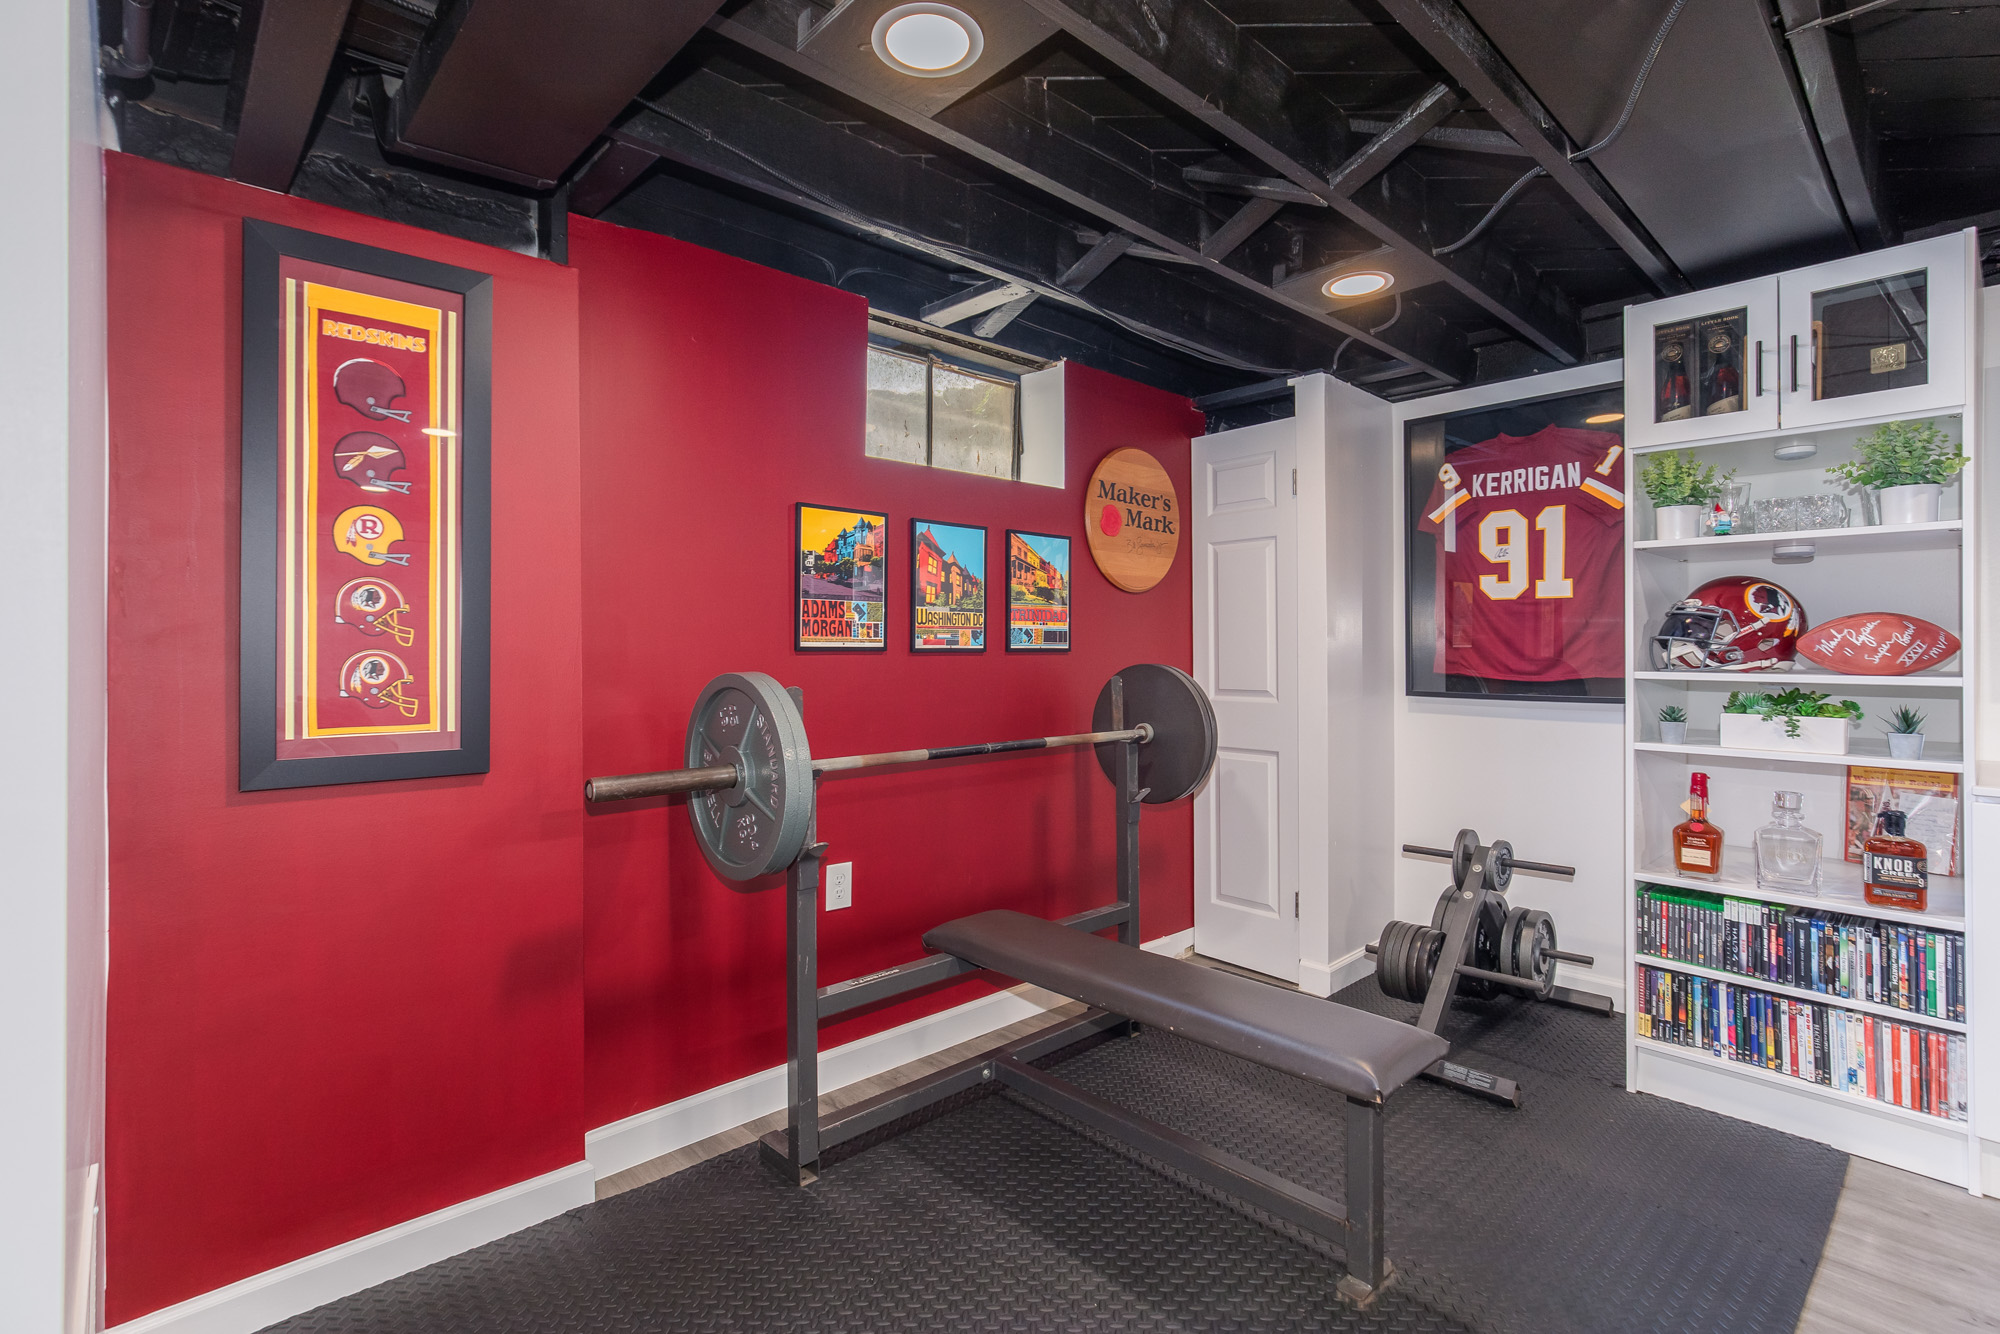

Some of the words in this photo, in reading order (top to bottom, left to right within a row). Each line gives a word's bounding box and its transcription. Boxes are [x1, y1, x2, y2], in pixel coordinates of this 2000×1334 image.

[321, 318, 427, 354] REDSKINS
[1438, 462, 1462, 490] 9
[1472, 461, 1581, 498] KERRIGAN
[1097, 479, 1171, 512] Maker's
[360, 518, 378, 536] R
[1125, 508, 1175, 535] Mark
[1479, 504, 1574, 600] 91
[802, 599, 845, 619] ADAMS
[916, 608, 970, 627] WASHINGTON
[972, 613, 983, 627] DC
[1011, 608, 1067, 623] TRINIDAD
[802, 619, 852, 637] MORGAN
[1864, 638, 1896, 664] Super
[1892, 620, 1918, 646] Bowl
[756, 714, 779, 809] STANDARD
[1873, 856, 1914, 873] KNOB
[1880, 869, 1921, 879] CREEK
[1917, 878, 1925, 888] 9
[1928, 970, 1936, 980] ted
